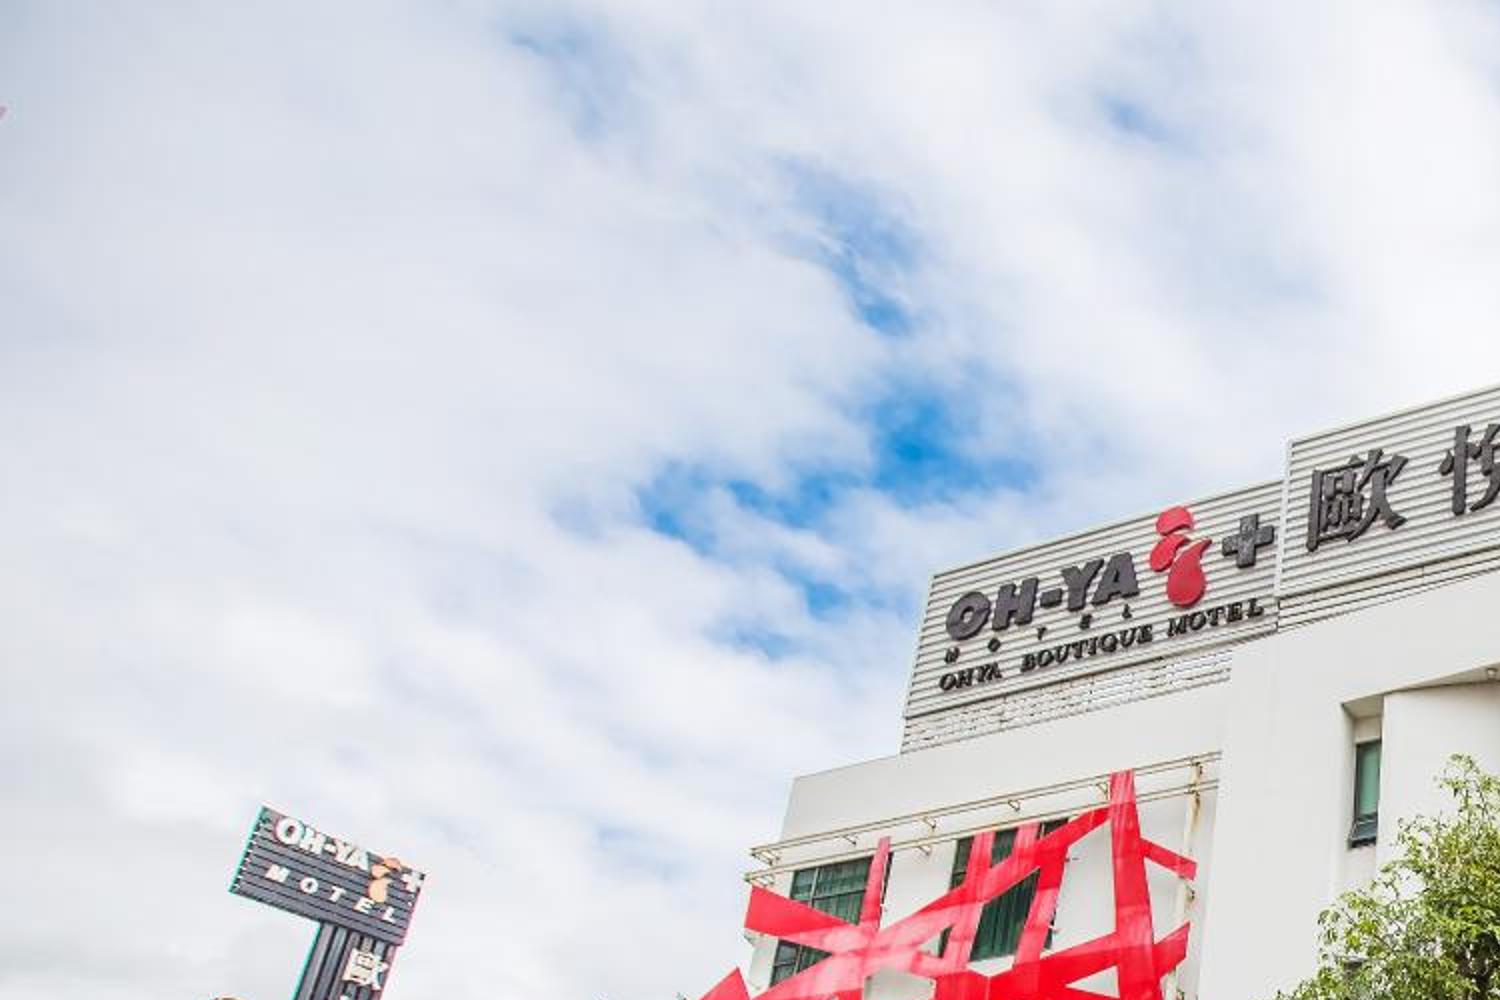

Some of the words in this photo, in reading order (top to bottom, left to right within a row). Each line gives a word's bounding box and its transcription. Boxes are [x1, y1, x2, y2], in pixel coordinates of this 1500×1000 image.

[945, 552, 1140, 641] OH-YA
[939, 664, 1003, 692] OHYA
[1020, 624, 1153, 672] BOUTIQUE
[1167, 598, 1265, 637] MOTEL
[275, 817, 370, 871] OH-YA
[265, 864, 397, 914] MOTEL
